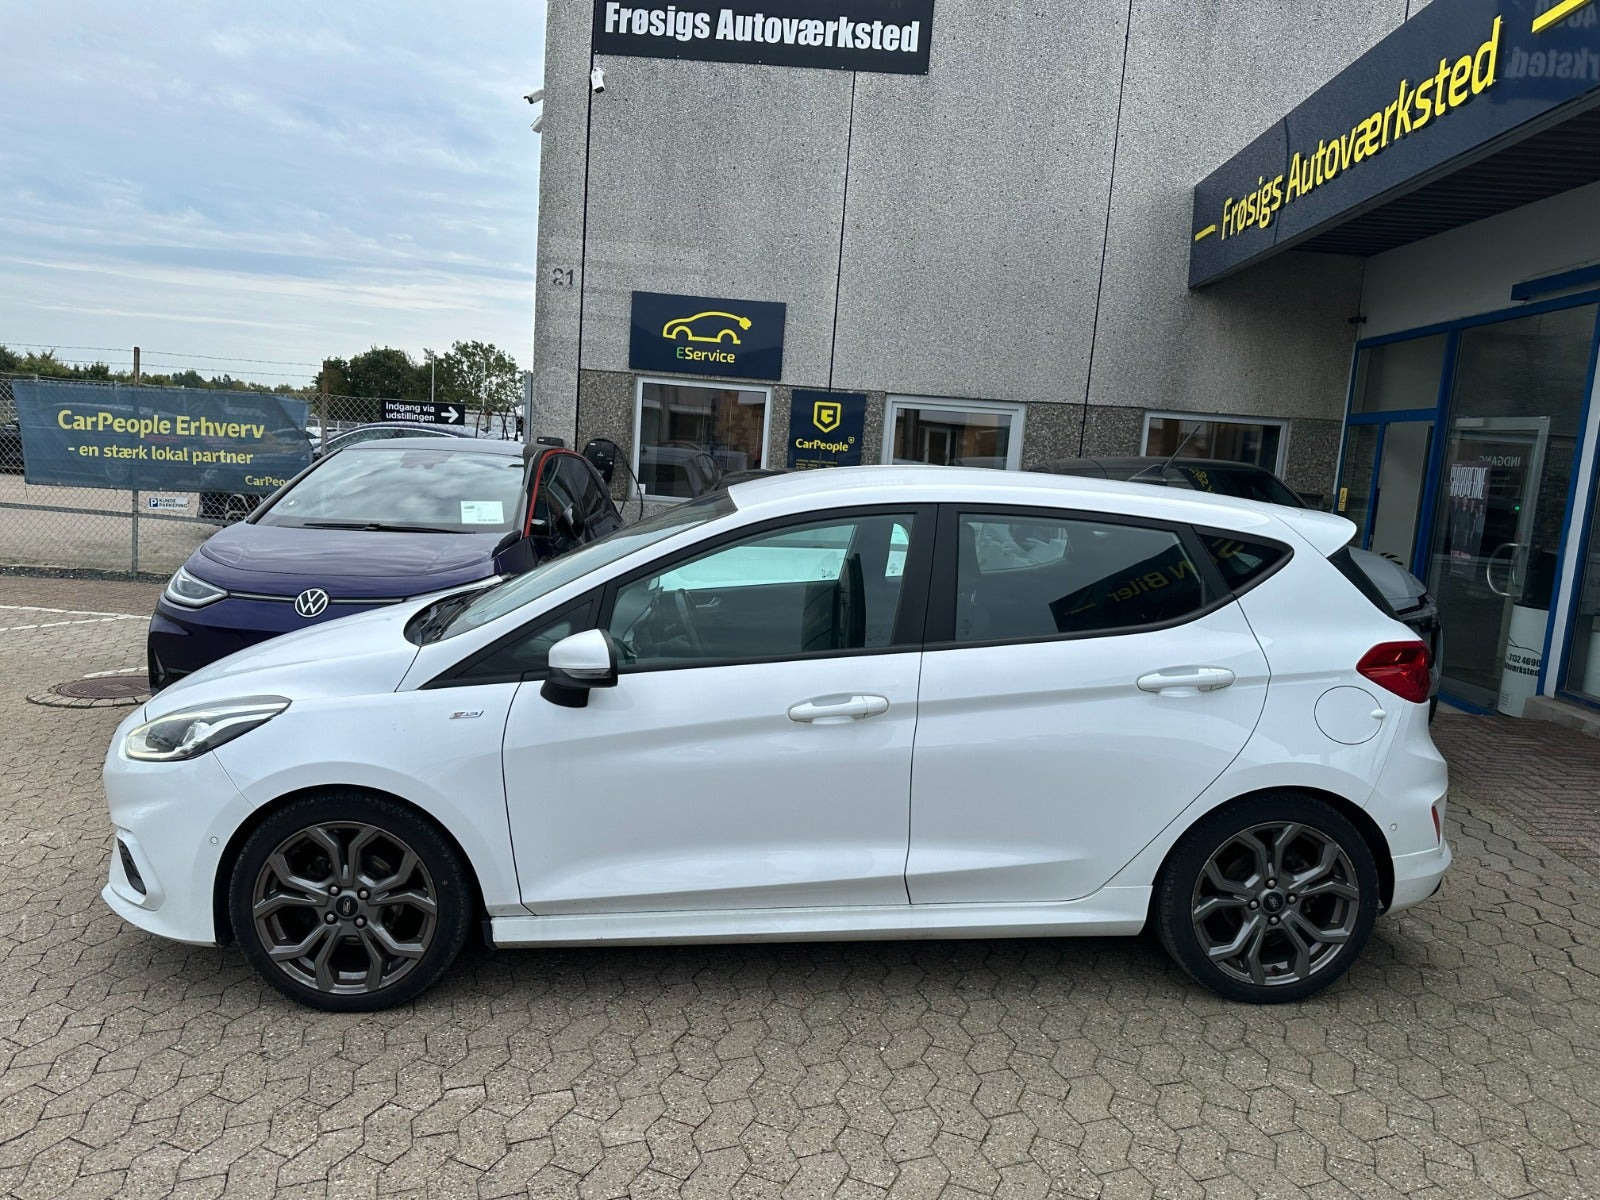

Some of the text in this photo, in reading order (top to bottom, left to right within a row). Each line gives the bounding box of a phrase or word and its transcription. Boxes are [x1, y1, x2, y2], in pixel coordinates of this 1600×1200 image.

[605, 2, 920, 52] Frøsigs Autoværksted
[1221, 15, 1502, 240] Frøsigs Autoværksted
[552, 268, 574, 286] 21
[676, 347, 735, 364] EService
[385, 402, 435, 413] Indgang via
[57, 409, 265, 439] CarPeople Erhverv
[385, 411, 435, 422] udstillingen
[795, 438, 849, 453] CarPeople
[79, 444, 99, 457] en
[103, 444, 148, 459] stærk
[151, 445, 189, 462] lokal
[192, 450, 254, 465] partner
[244, 475, 286, 487] CarPeo
